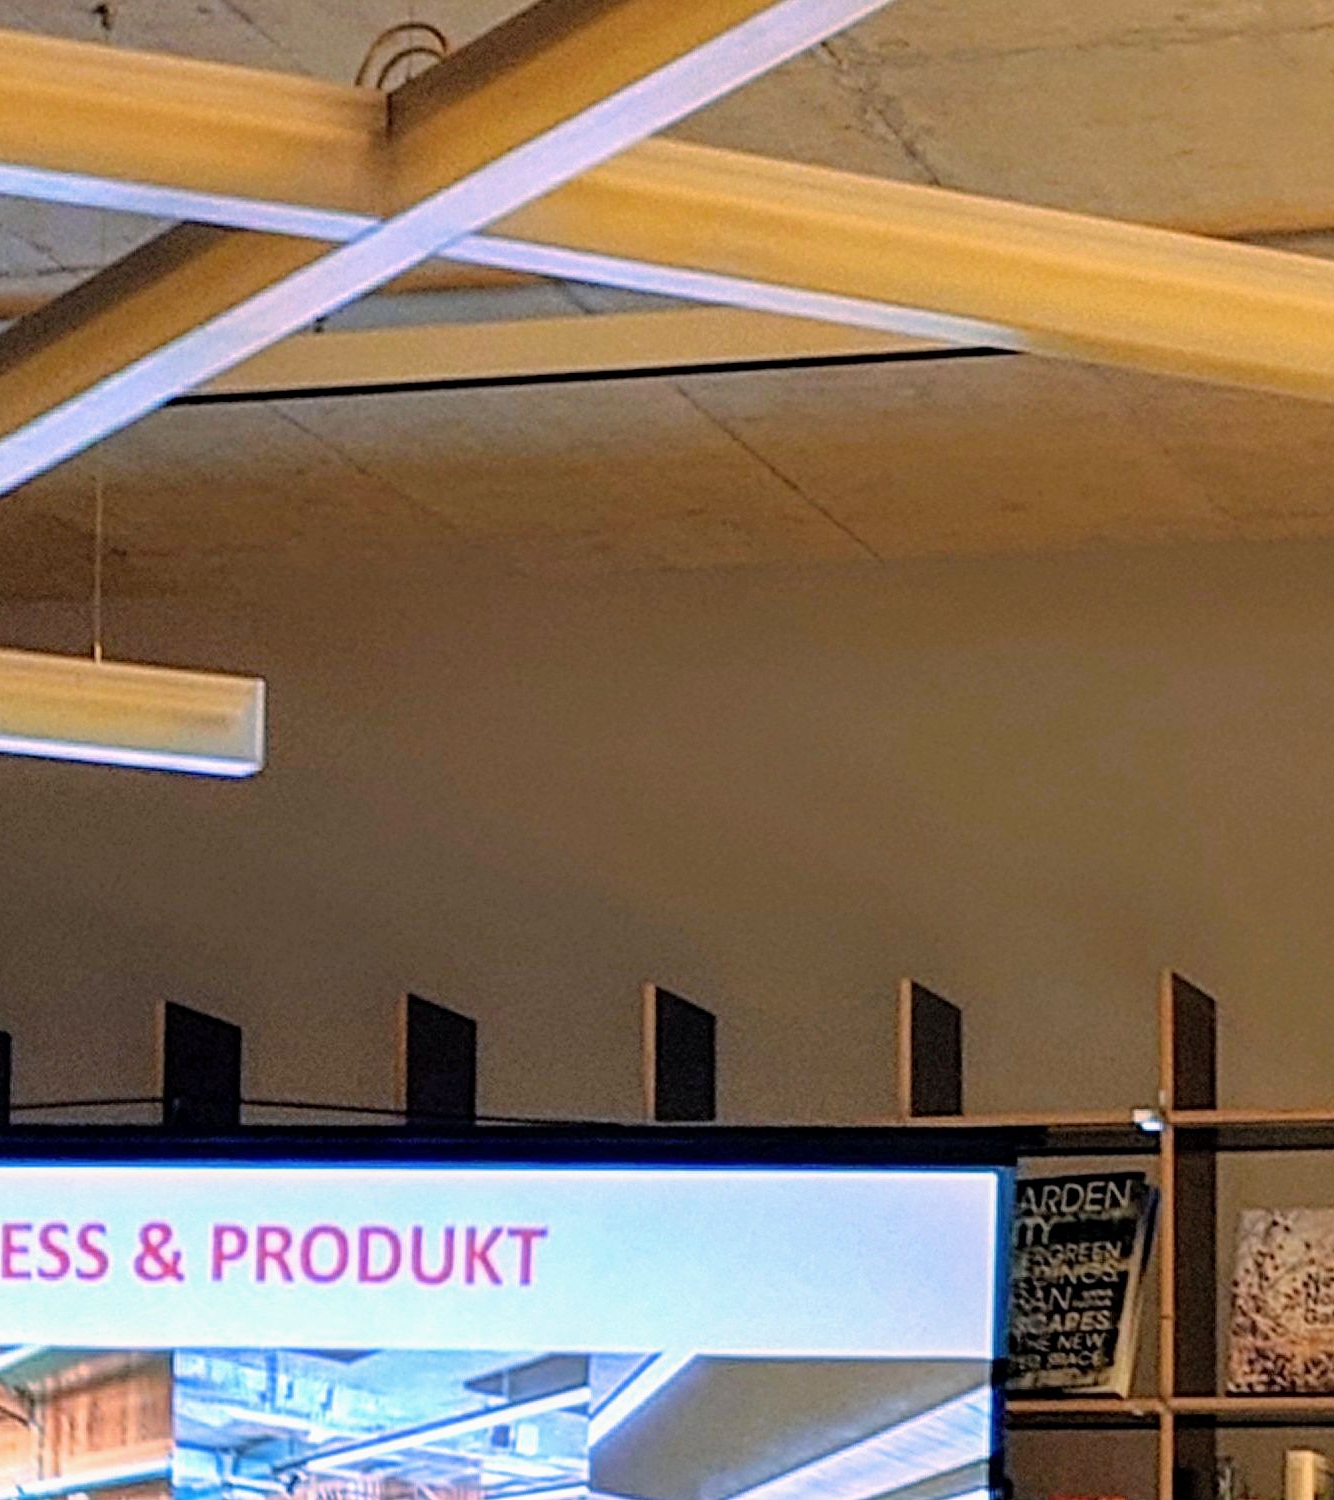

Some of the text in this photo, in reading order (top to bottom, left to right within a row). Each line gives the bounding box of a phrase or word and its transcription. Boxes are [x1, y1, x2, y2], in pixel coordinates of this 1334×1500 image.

[1020, 1179, 1132, 1214] ARDEN
[133, 1222, 185, 1283] &
[211, 1224, 549, 1287] PRODUKT
